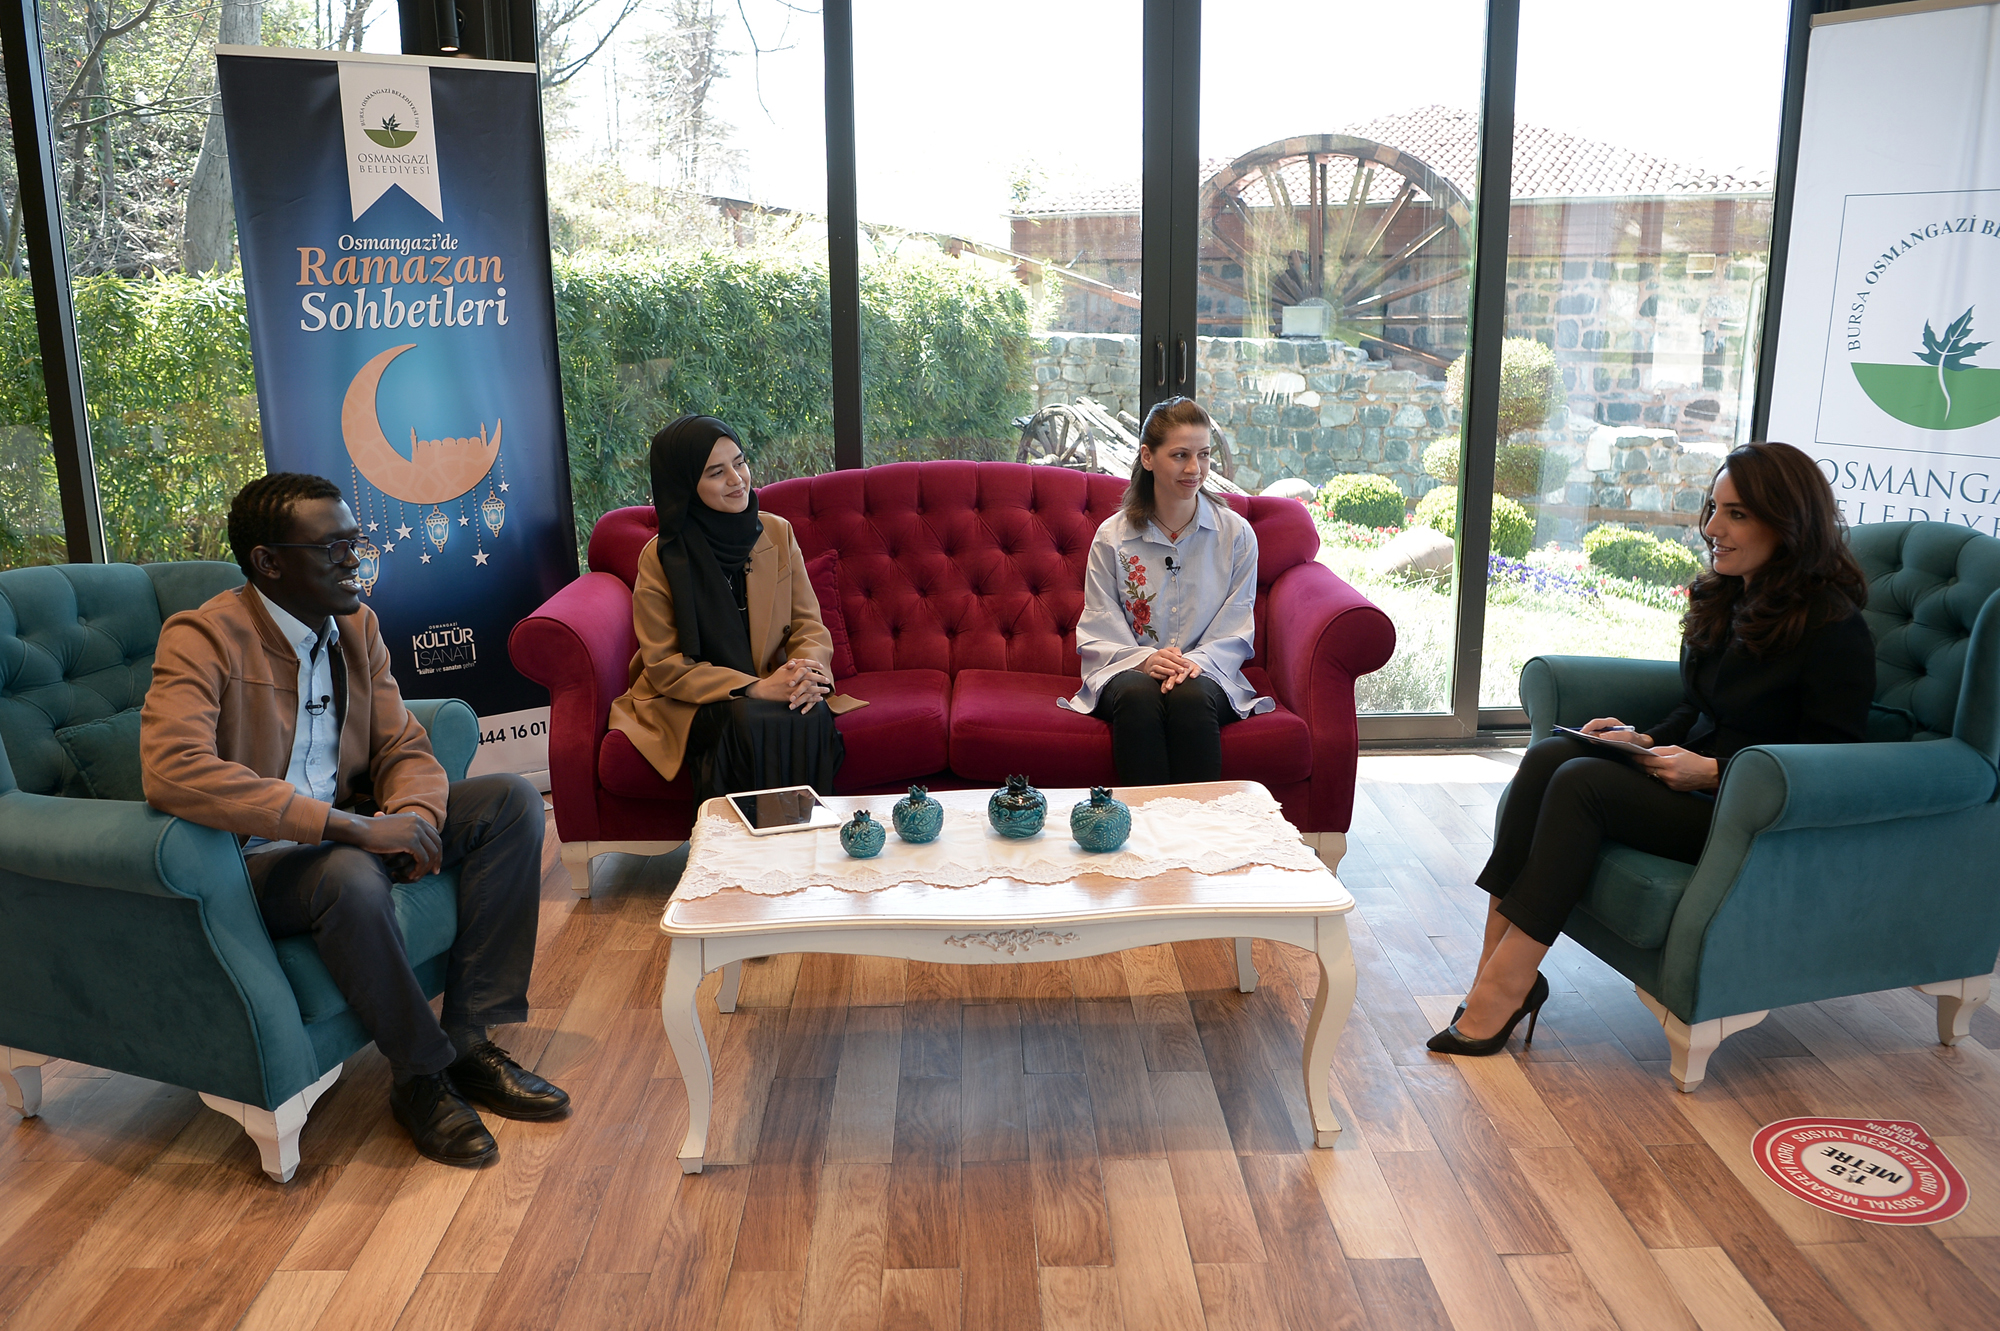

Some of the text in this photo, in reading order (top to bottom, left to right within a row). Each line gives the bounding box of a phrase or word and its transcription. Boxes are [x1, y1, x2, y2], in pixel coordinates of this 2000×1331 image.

[361, 88, 391, 107] OSMANGAZİ
[391, 89, 419, 116] BELEDİYESİ
[357, 153, 429, 165] OSMANGAZİ
[359, 165, 430, 175] BELEDİYESİ
[338, 233, 459, 256] Osmangazi'de
[296, 247, 505, 286] Ramazan
[1847, 289, 1871, 352] BURSA
[1864, 214, 1977, 286] OSMANGAZİ
[300, 286, 509, 332] Sohbetleri
[412, 627, 475, 650] KÜLTÜR
[419, 645, 471, 667] SANAT
[478, 720, 547, 745] 444 16 01
[1778, 1142, 1925, 1211] SOSYAL MESAFEYİ KORU
[1791, 1129, 1938, 1196] SOSYAL MESAFEYİ KORU
[1820, 1145, 1903, 1184] METRE
